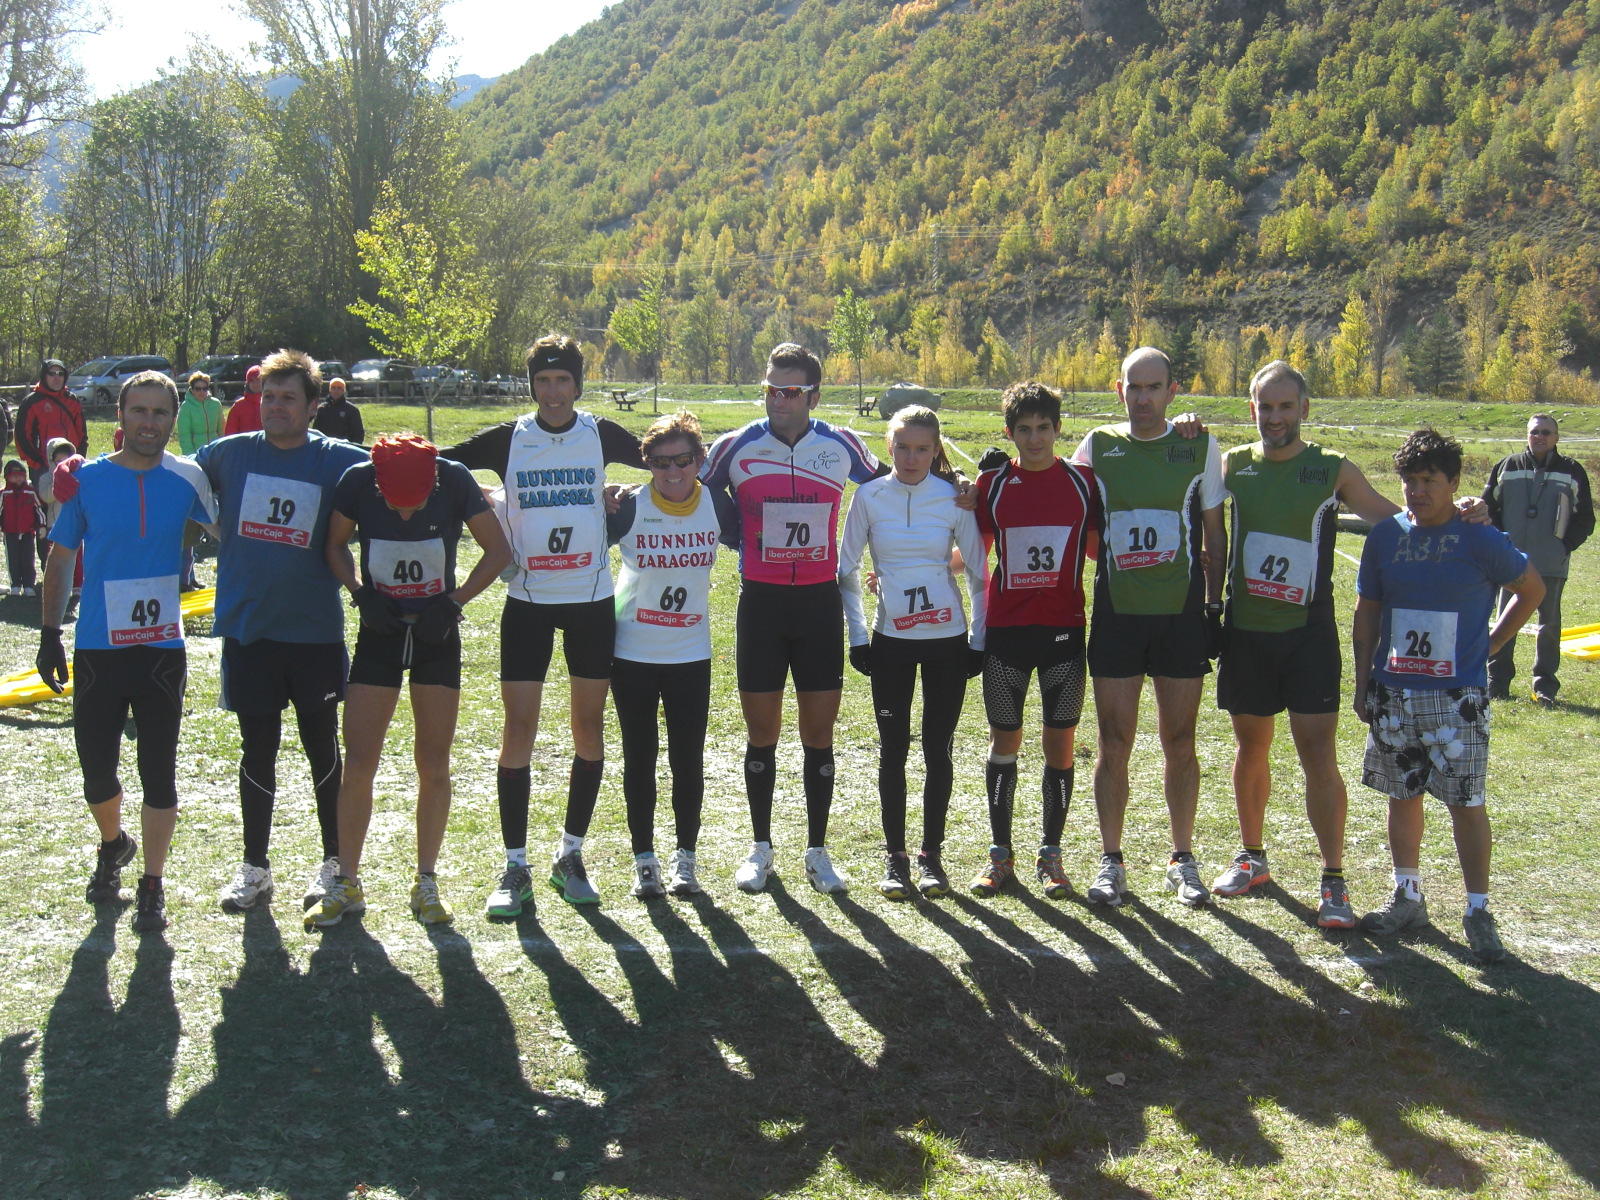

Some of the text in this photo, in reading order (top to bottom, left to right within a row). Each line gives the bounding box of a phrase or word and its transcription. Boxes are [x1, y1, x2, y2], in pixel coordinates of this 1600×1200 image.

[516, 468, 596, 488] RUNNING
[518, 488, 596, 509] ZARAGOZA
[267, 497, 295, 525] 19
[245, 524, 283, 539] iberCaja
[548, 527, 573, 554] 67
[636, 531, 715, 549] RUNNING
[786, 522, 810, 547] 70
[1129, 527, 1158, 551] 10
[531, 559, 568, 570] iberCaja
[637, 552, 713, 569] ZARAGOZA
[768, 551, 805, 559] iberCaja
[1027, 546, 1055, 571] 33
[1120, 555, 1150, 565] iberCaja
[394, 560, 424, 583] 40
[1259, 554, 1290, 583] 42
[1014, 576, 1050, 587] iberCaja
[660, 586, 688, 612] 69
[904, 586, 934, 614] 71
[131, 599, 161, 626] 49
[640, 612, 677, 625] iberCaja
[898, 614, 931, 627] iberCaja
[115, 631, 155, 642] iberCaja
[1405, 630, 1431, 657] 26
[994, 773, 1003, 806] SALOMON
[1059, 778, 1068, 809] SALOMON
